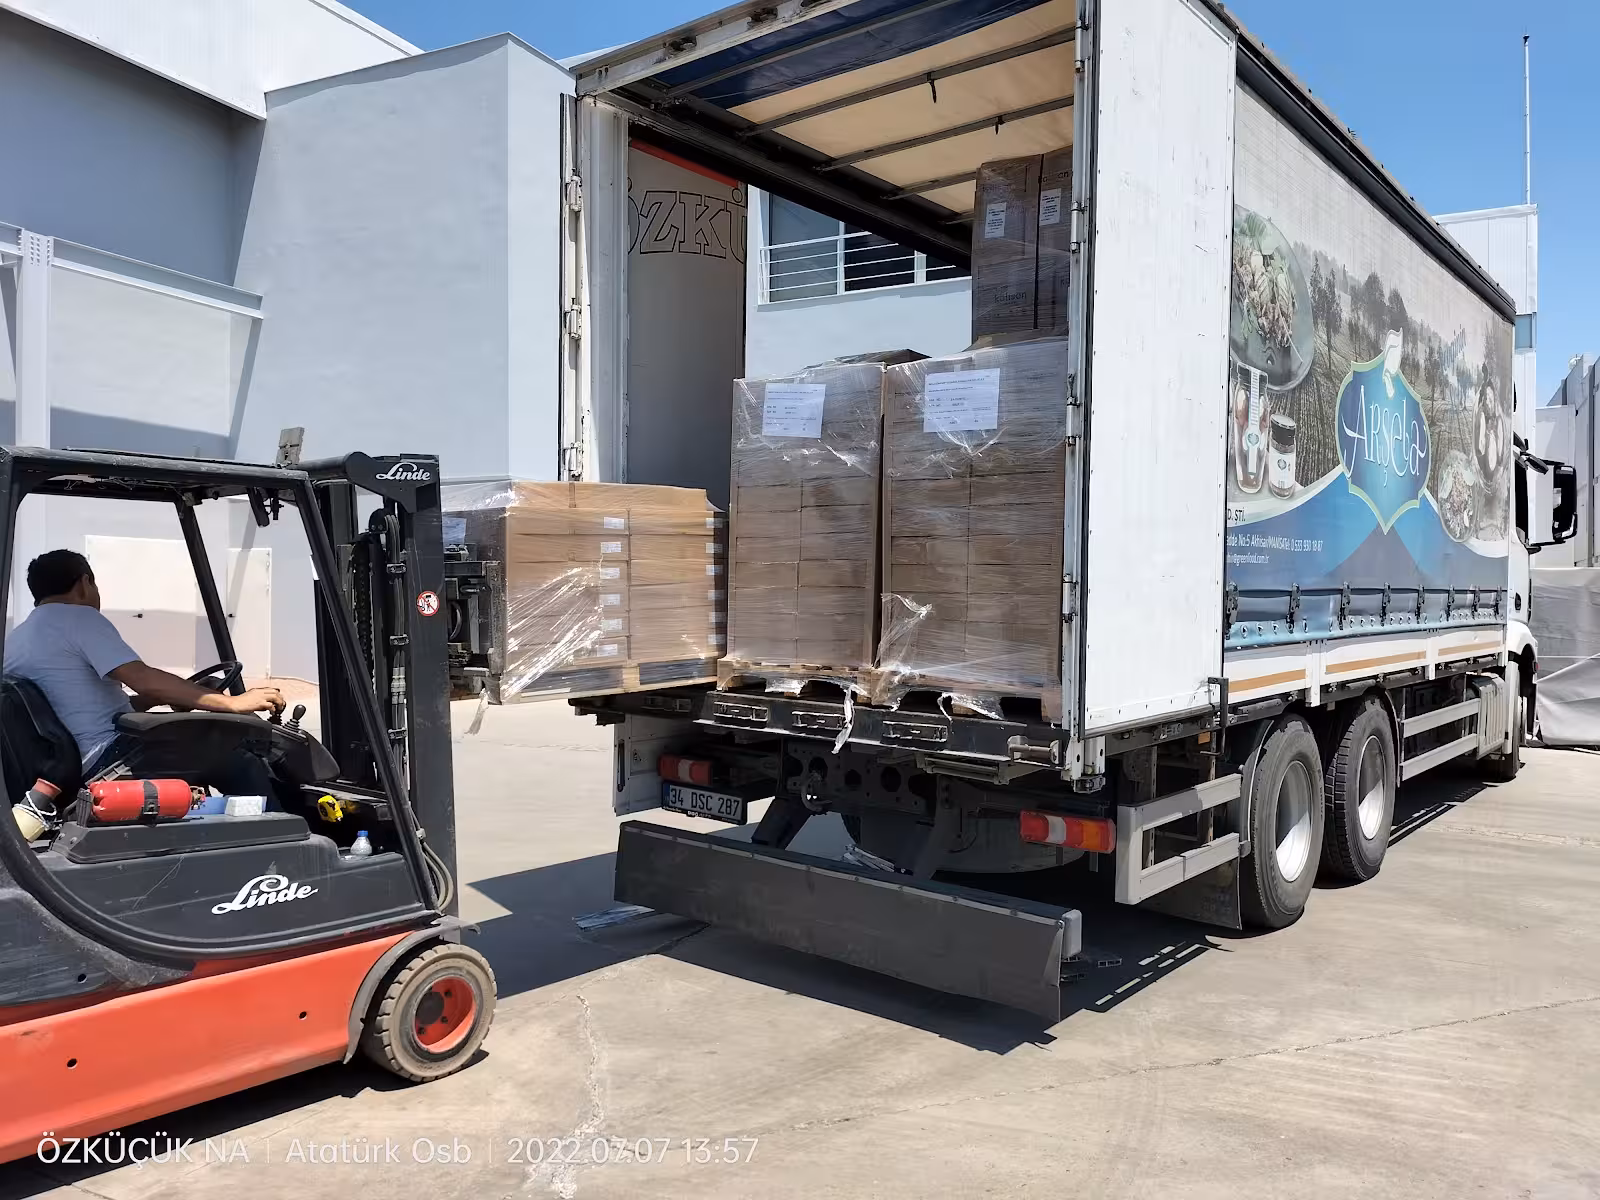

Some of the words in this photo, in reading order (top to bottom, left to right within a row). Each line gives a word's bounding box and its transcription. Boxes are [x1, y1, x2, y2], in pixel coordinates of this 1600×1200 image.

[628, 177, 746, 264] ZKÜ
[376, 462, 431, 480] Linde
[670, 788, 684, 806] 34
[691, 791, 713, 811] DSC
[717, 797, 740, 817] 287
[211, 874, 319, 915] Linde
